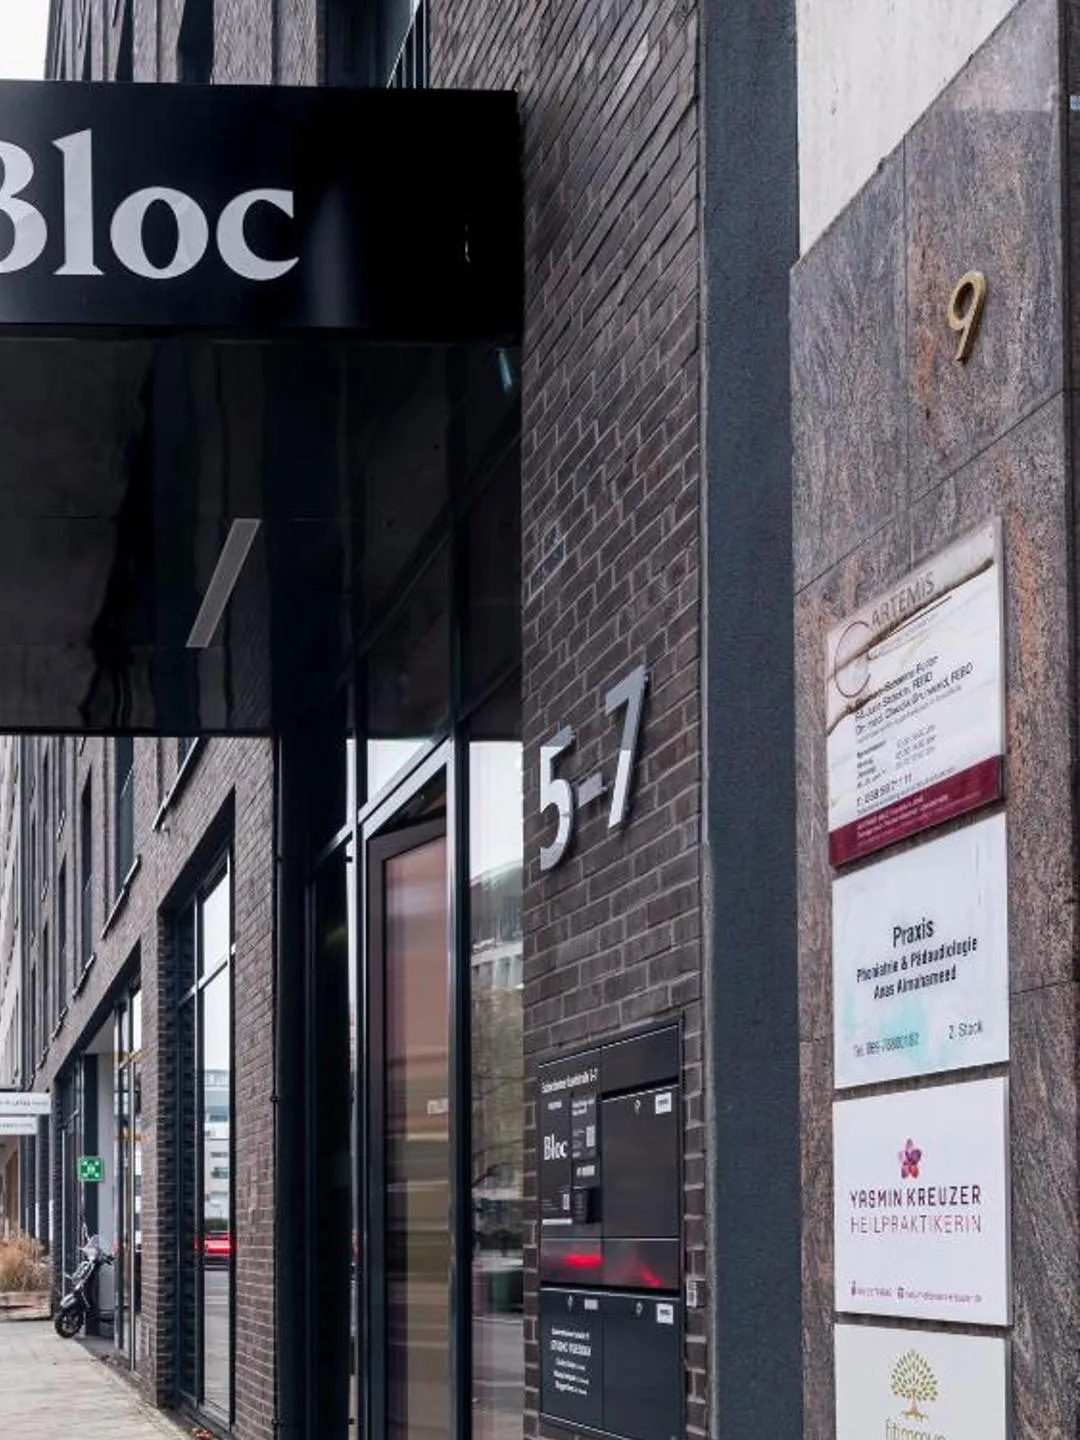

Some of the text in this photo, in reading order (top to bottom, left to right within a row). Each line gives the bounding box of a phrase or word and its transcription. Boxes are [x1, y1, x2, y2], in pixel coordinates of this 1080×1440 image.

[947, 269, 988, 366] 9
[870, 571, 937, 628] ARTEMIS
[539, 663, 650, 872] 5-7
[892, 916, 935, 948] Praxis
[900, 955, 909, 971] &
[543, 1133, 569, 1161] Bloc
[850, 1184, 982, 1209] YASMIN KREUZER
[850, 1213, 983, 1234] HEILPRAKTIKERIN
